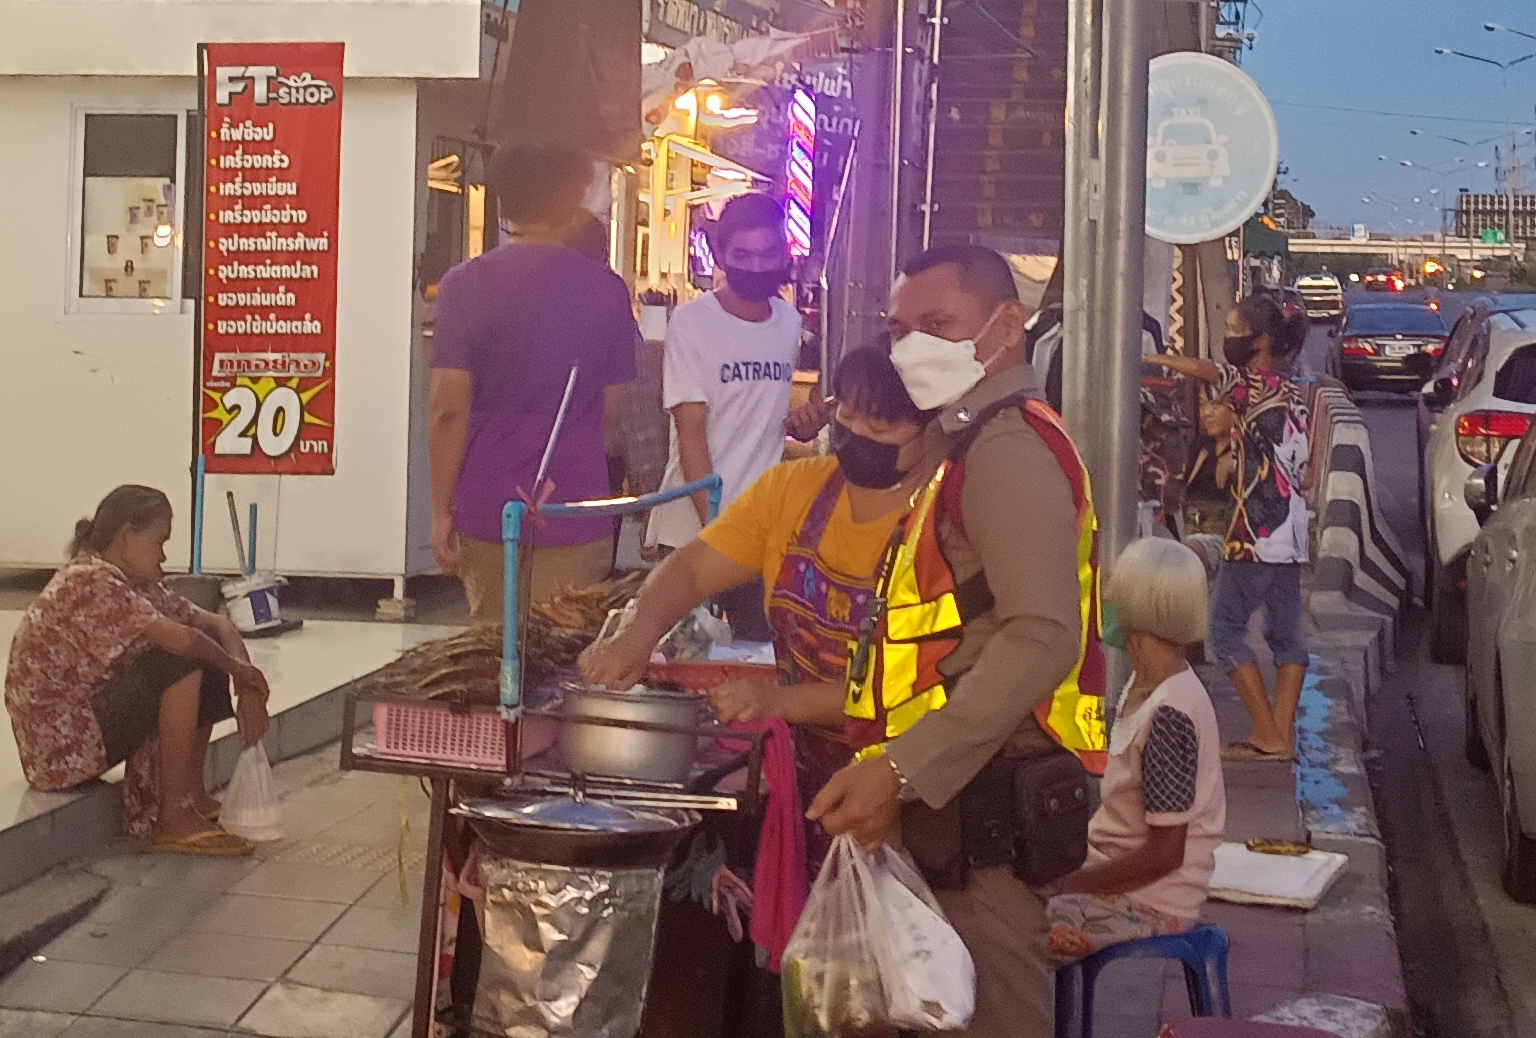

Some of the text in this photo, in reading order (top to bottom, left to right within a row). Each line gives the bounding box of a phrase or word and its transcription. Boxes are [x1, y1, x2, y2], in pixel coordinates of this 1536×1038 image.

[219, 143, 290, 169] เครื่องครัว
[219, 170, 298, 196] เครื่องเขียน
[219, 198, 308, 225] เครื่องมือช่าง
[217, 261, 320, 283] อุปกรณ์ตกปลา
[217, 288, 296, 307] ของเล่นเด็ก
[216, 314, 322, 335] ของใช้เบ็ดเตล็ด
[217, 353, 322, 376] ทุกอย่าง
[214, 386, 302, 457] 20
[299, 439, 328, 454] บาท
